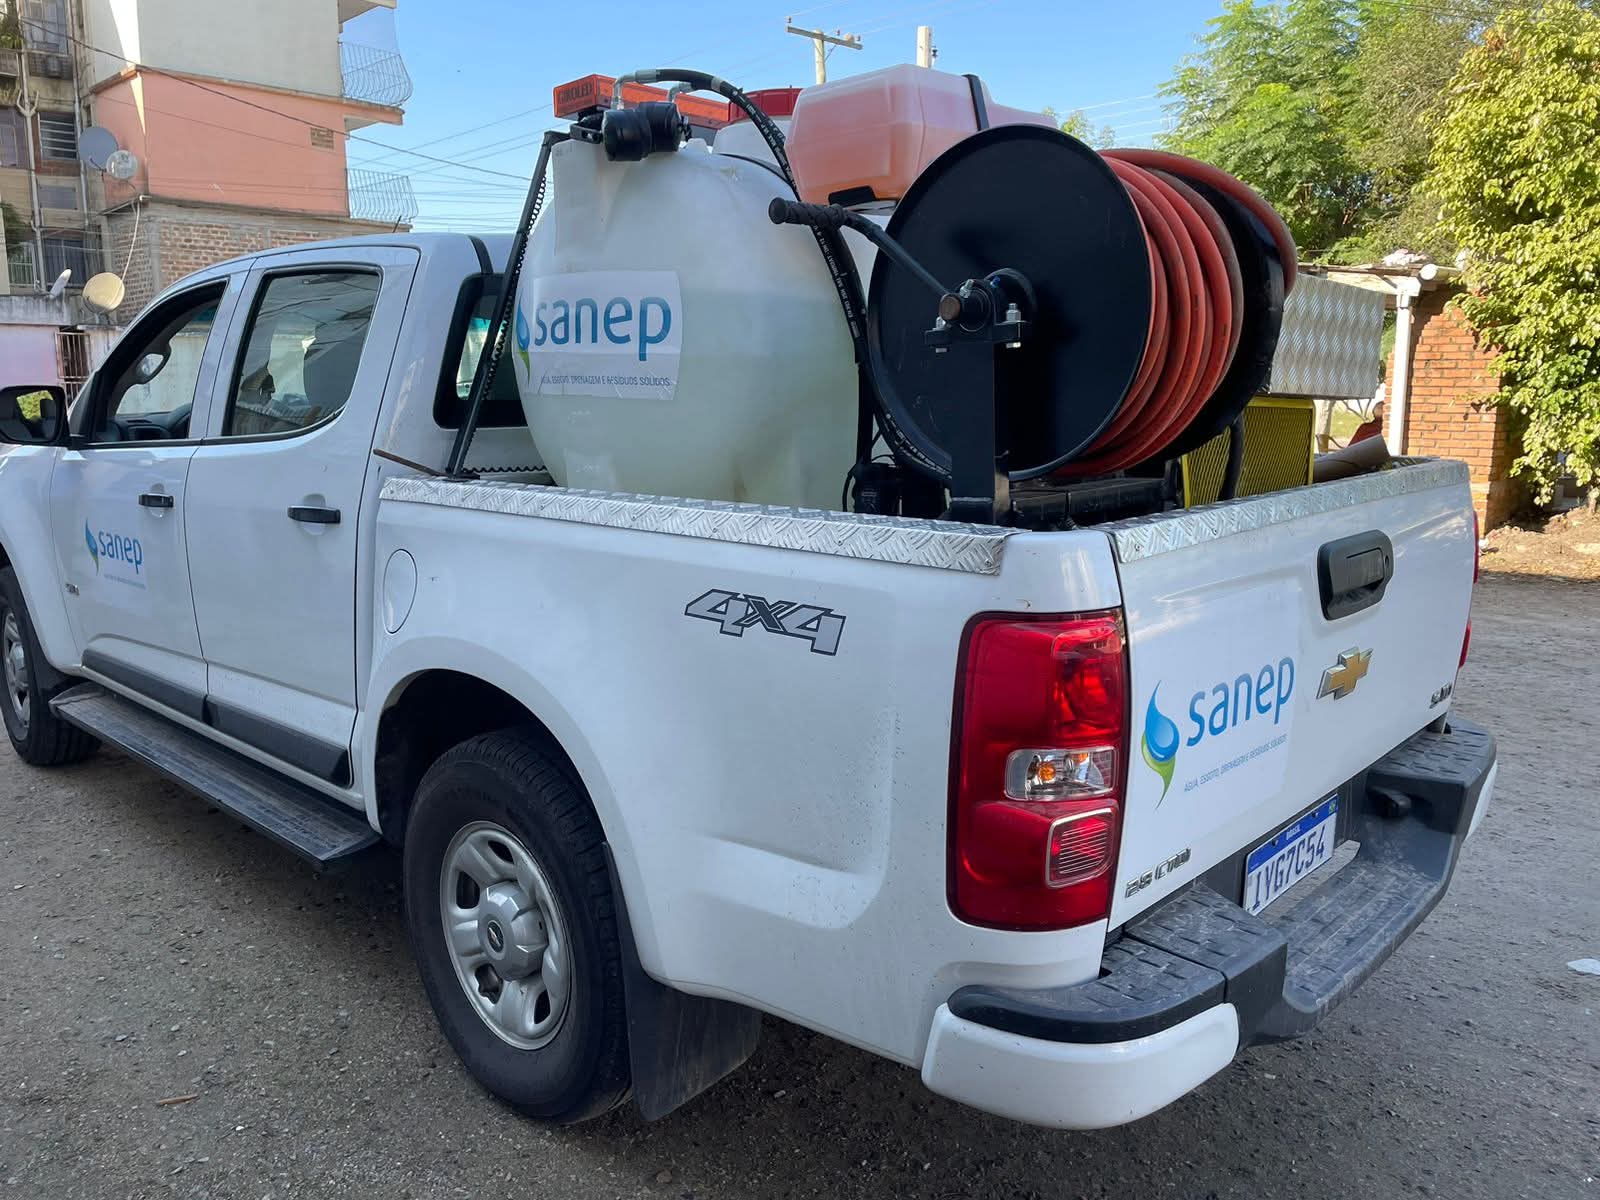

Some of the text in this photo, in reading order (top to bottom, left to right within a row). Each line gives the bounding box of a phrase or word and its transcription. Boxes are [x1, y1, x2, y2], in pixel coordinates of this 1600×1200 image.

[534, 296, 672, 361] sanep
[98, 530, 143, 575] sanep
[1186, 656, 1295, 747] sanep
[1252, 823, 1326, 911] IYG7C54
